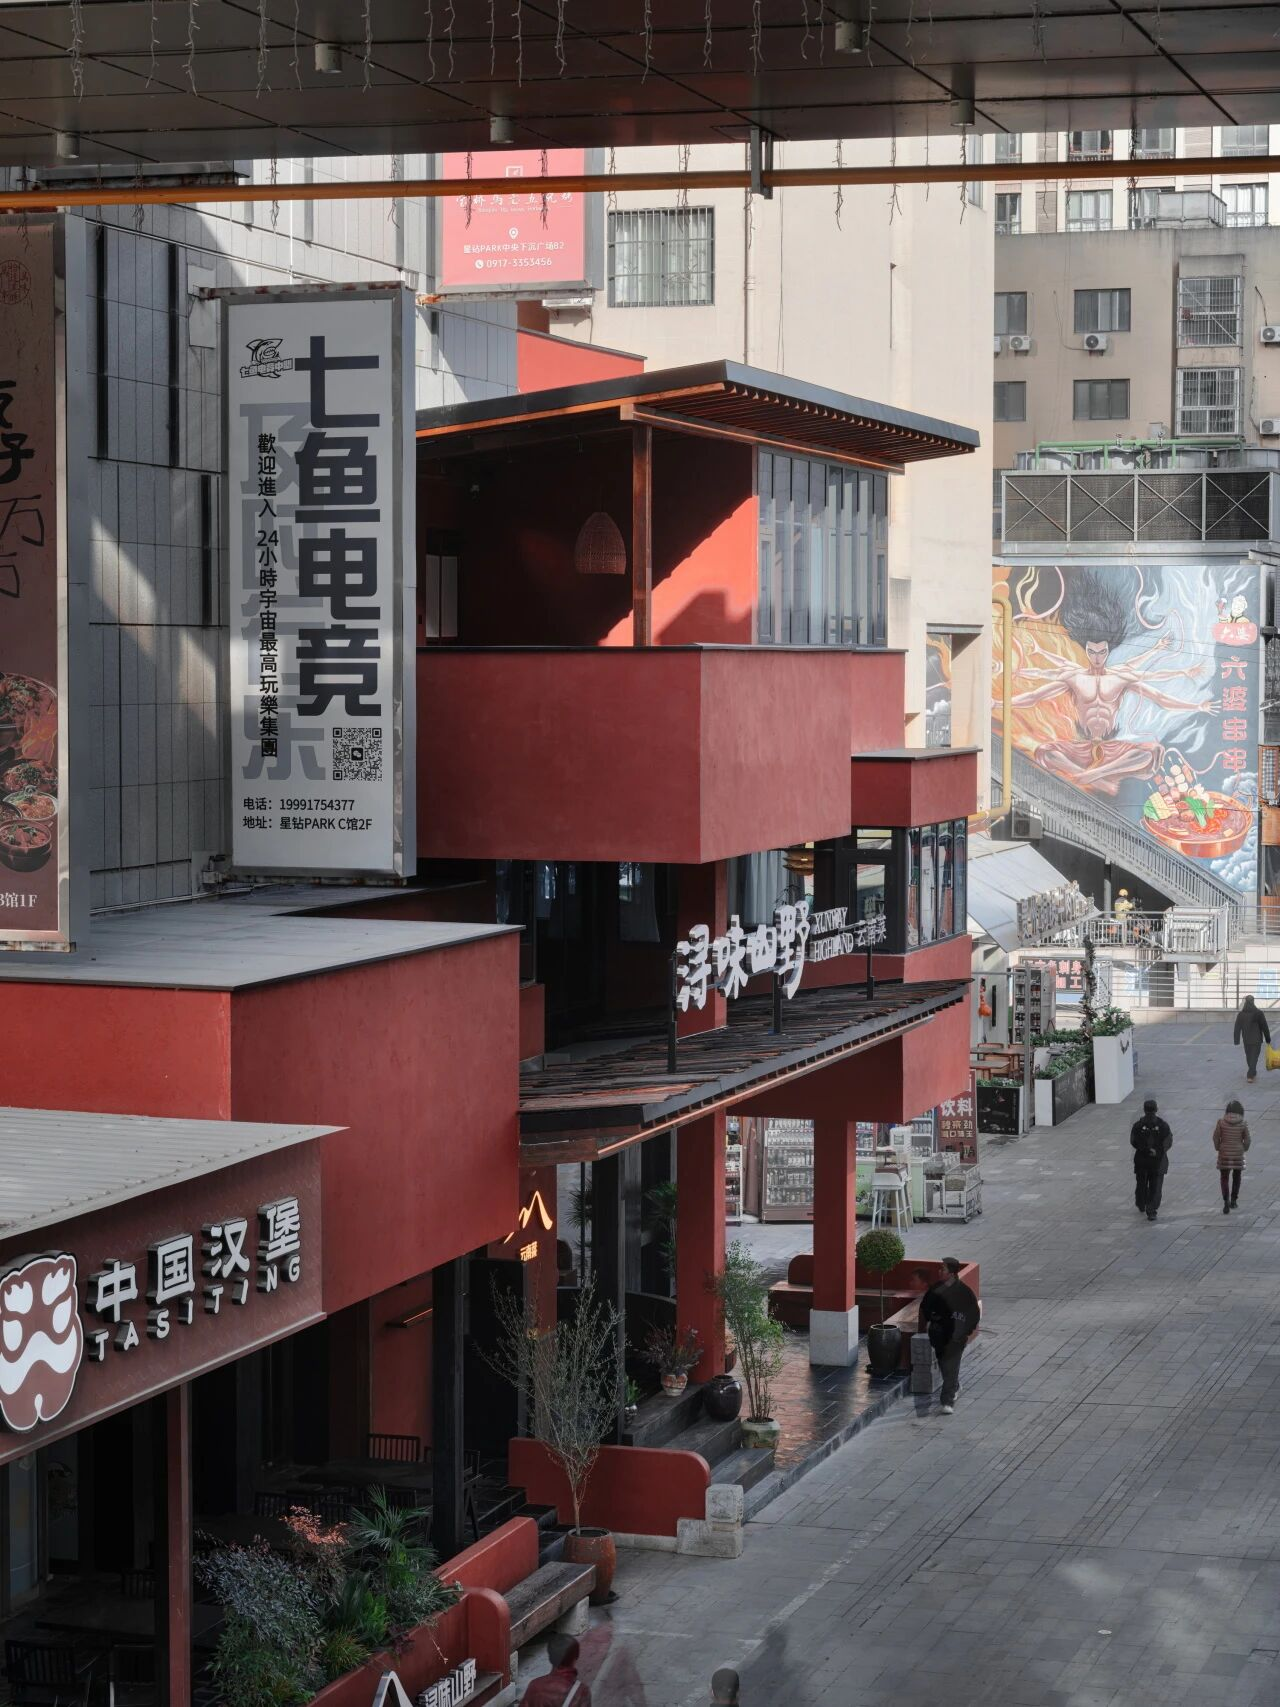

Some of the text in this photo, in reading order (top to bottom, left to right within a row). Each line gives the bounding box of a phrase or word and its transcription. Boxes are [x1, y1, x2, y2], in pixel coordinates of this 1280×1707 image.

[486, 259, 553, 269] 0917-3353456
[294, 336, 381, 717] 七鱼电竞
[88, 1197, 301, 1324] 中国汉堡
